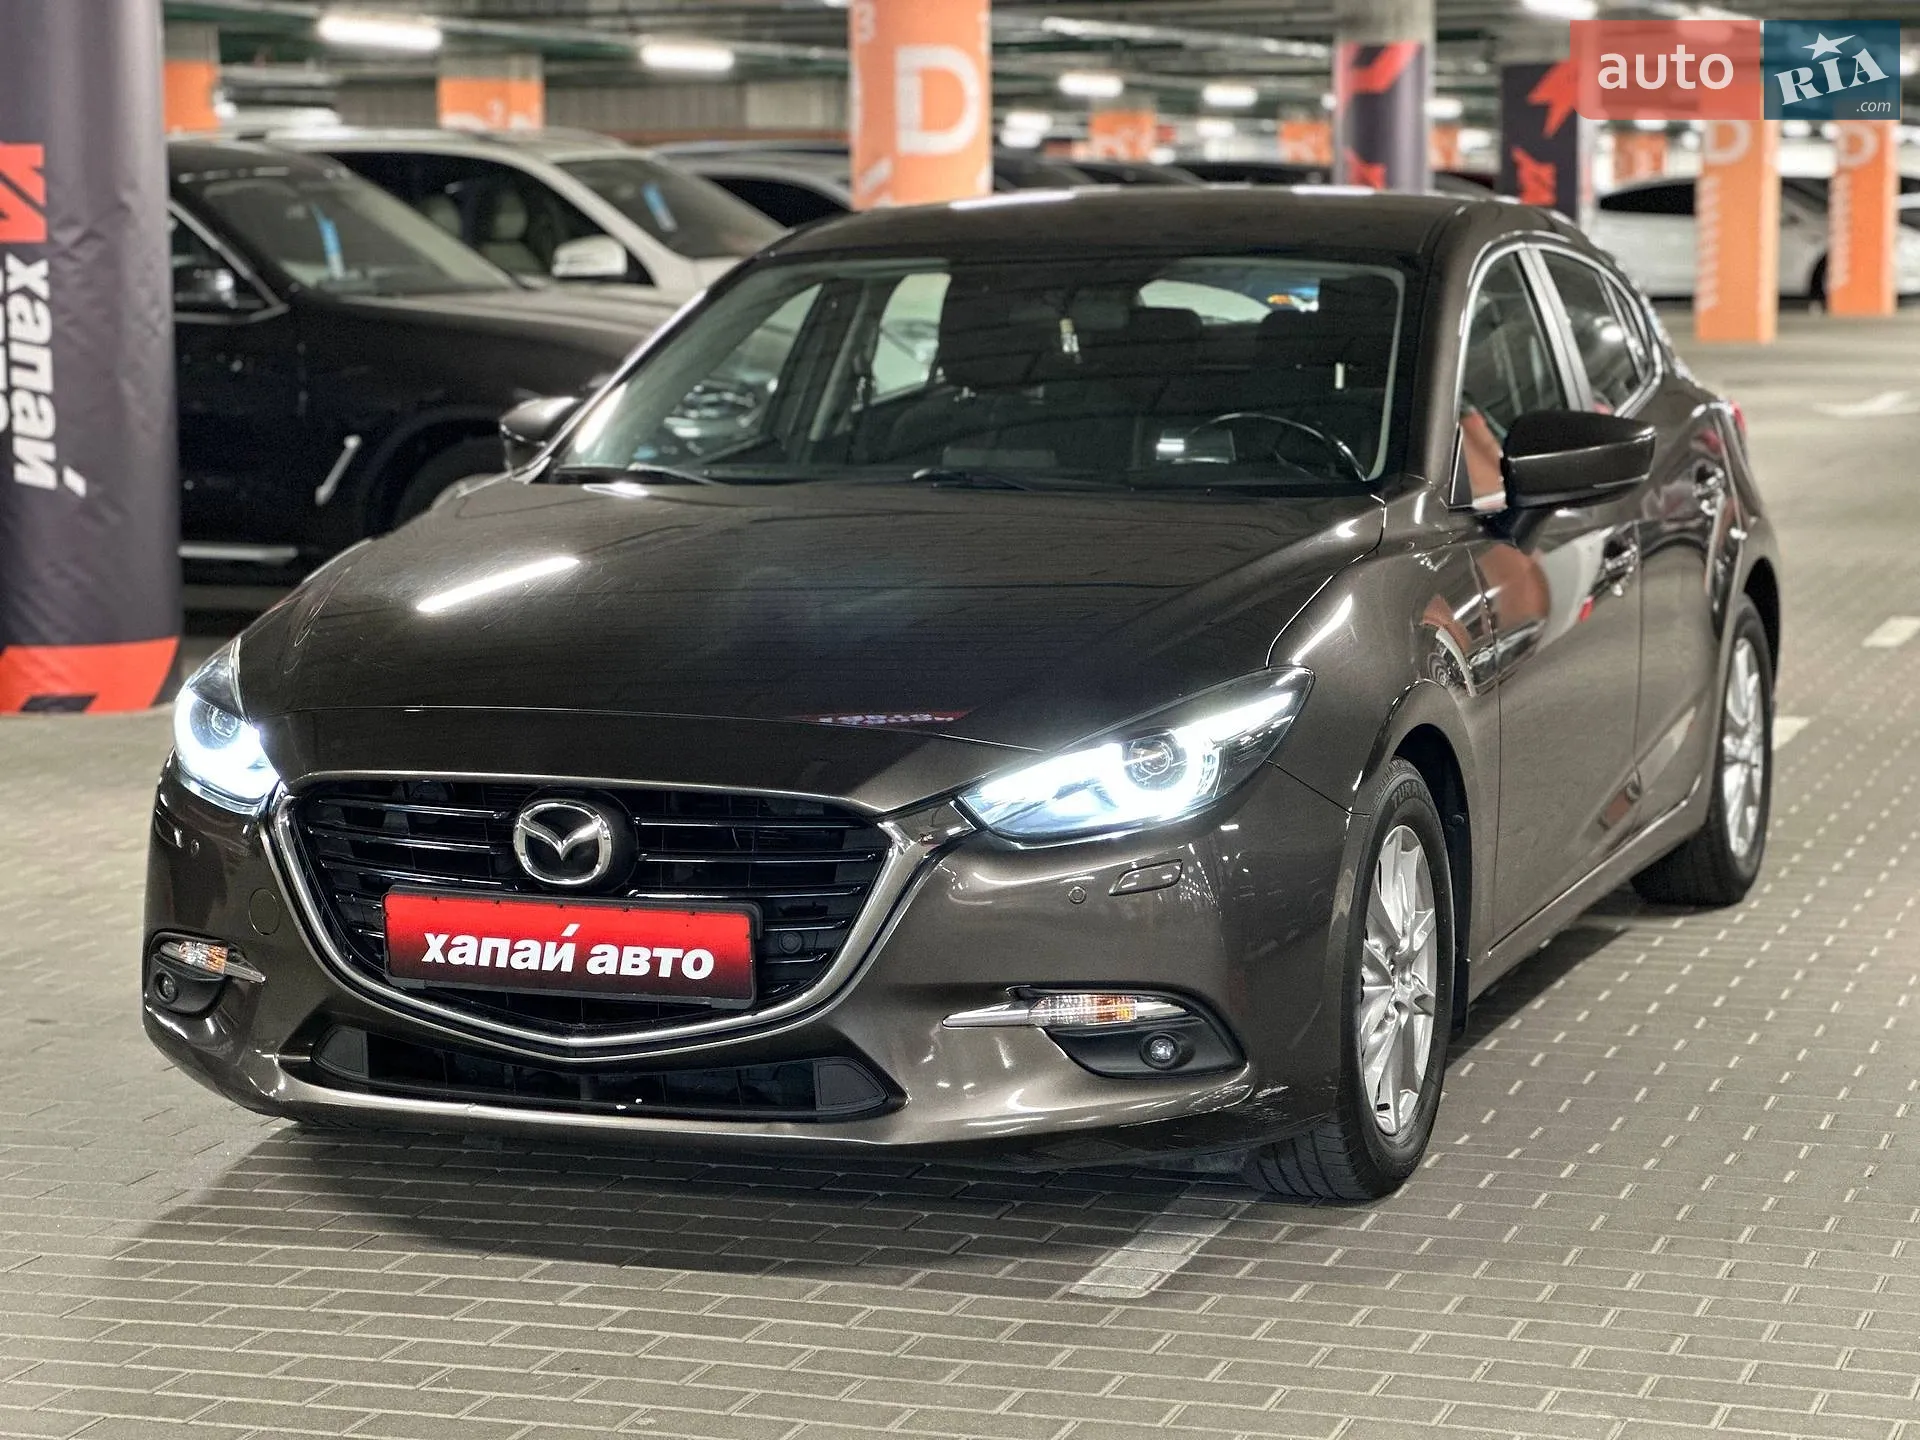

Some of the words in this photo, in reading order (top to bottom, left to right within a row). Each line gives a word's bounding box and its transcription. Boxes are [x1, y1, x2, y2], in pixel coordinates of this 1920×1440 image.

[896, 44, 980, 155] D
[421, 923, 581, 973] хапай
[586, 943, 715, 981] авто
